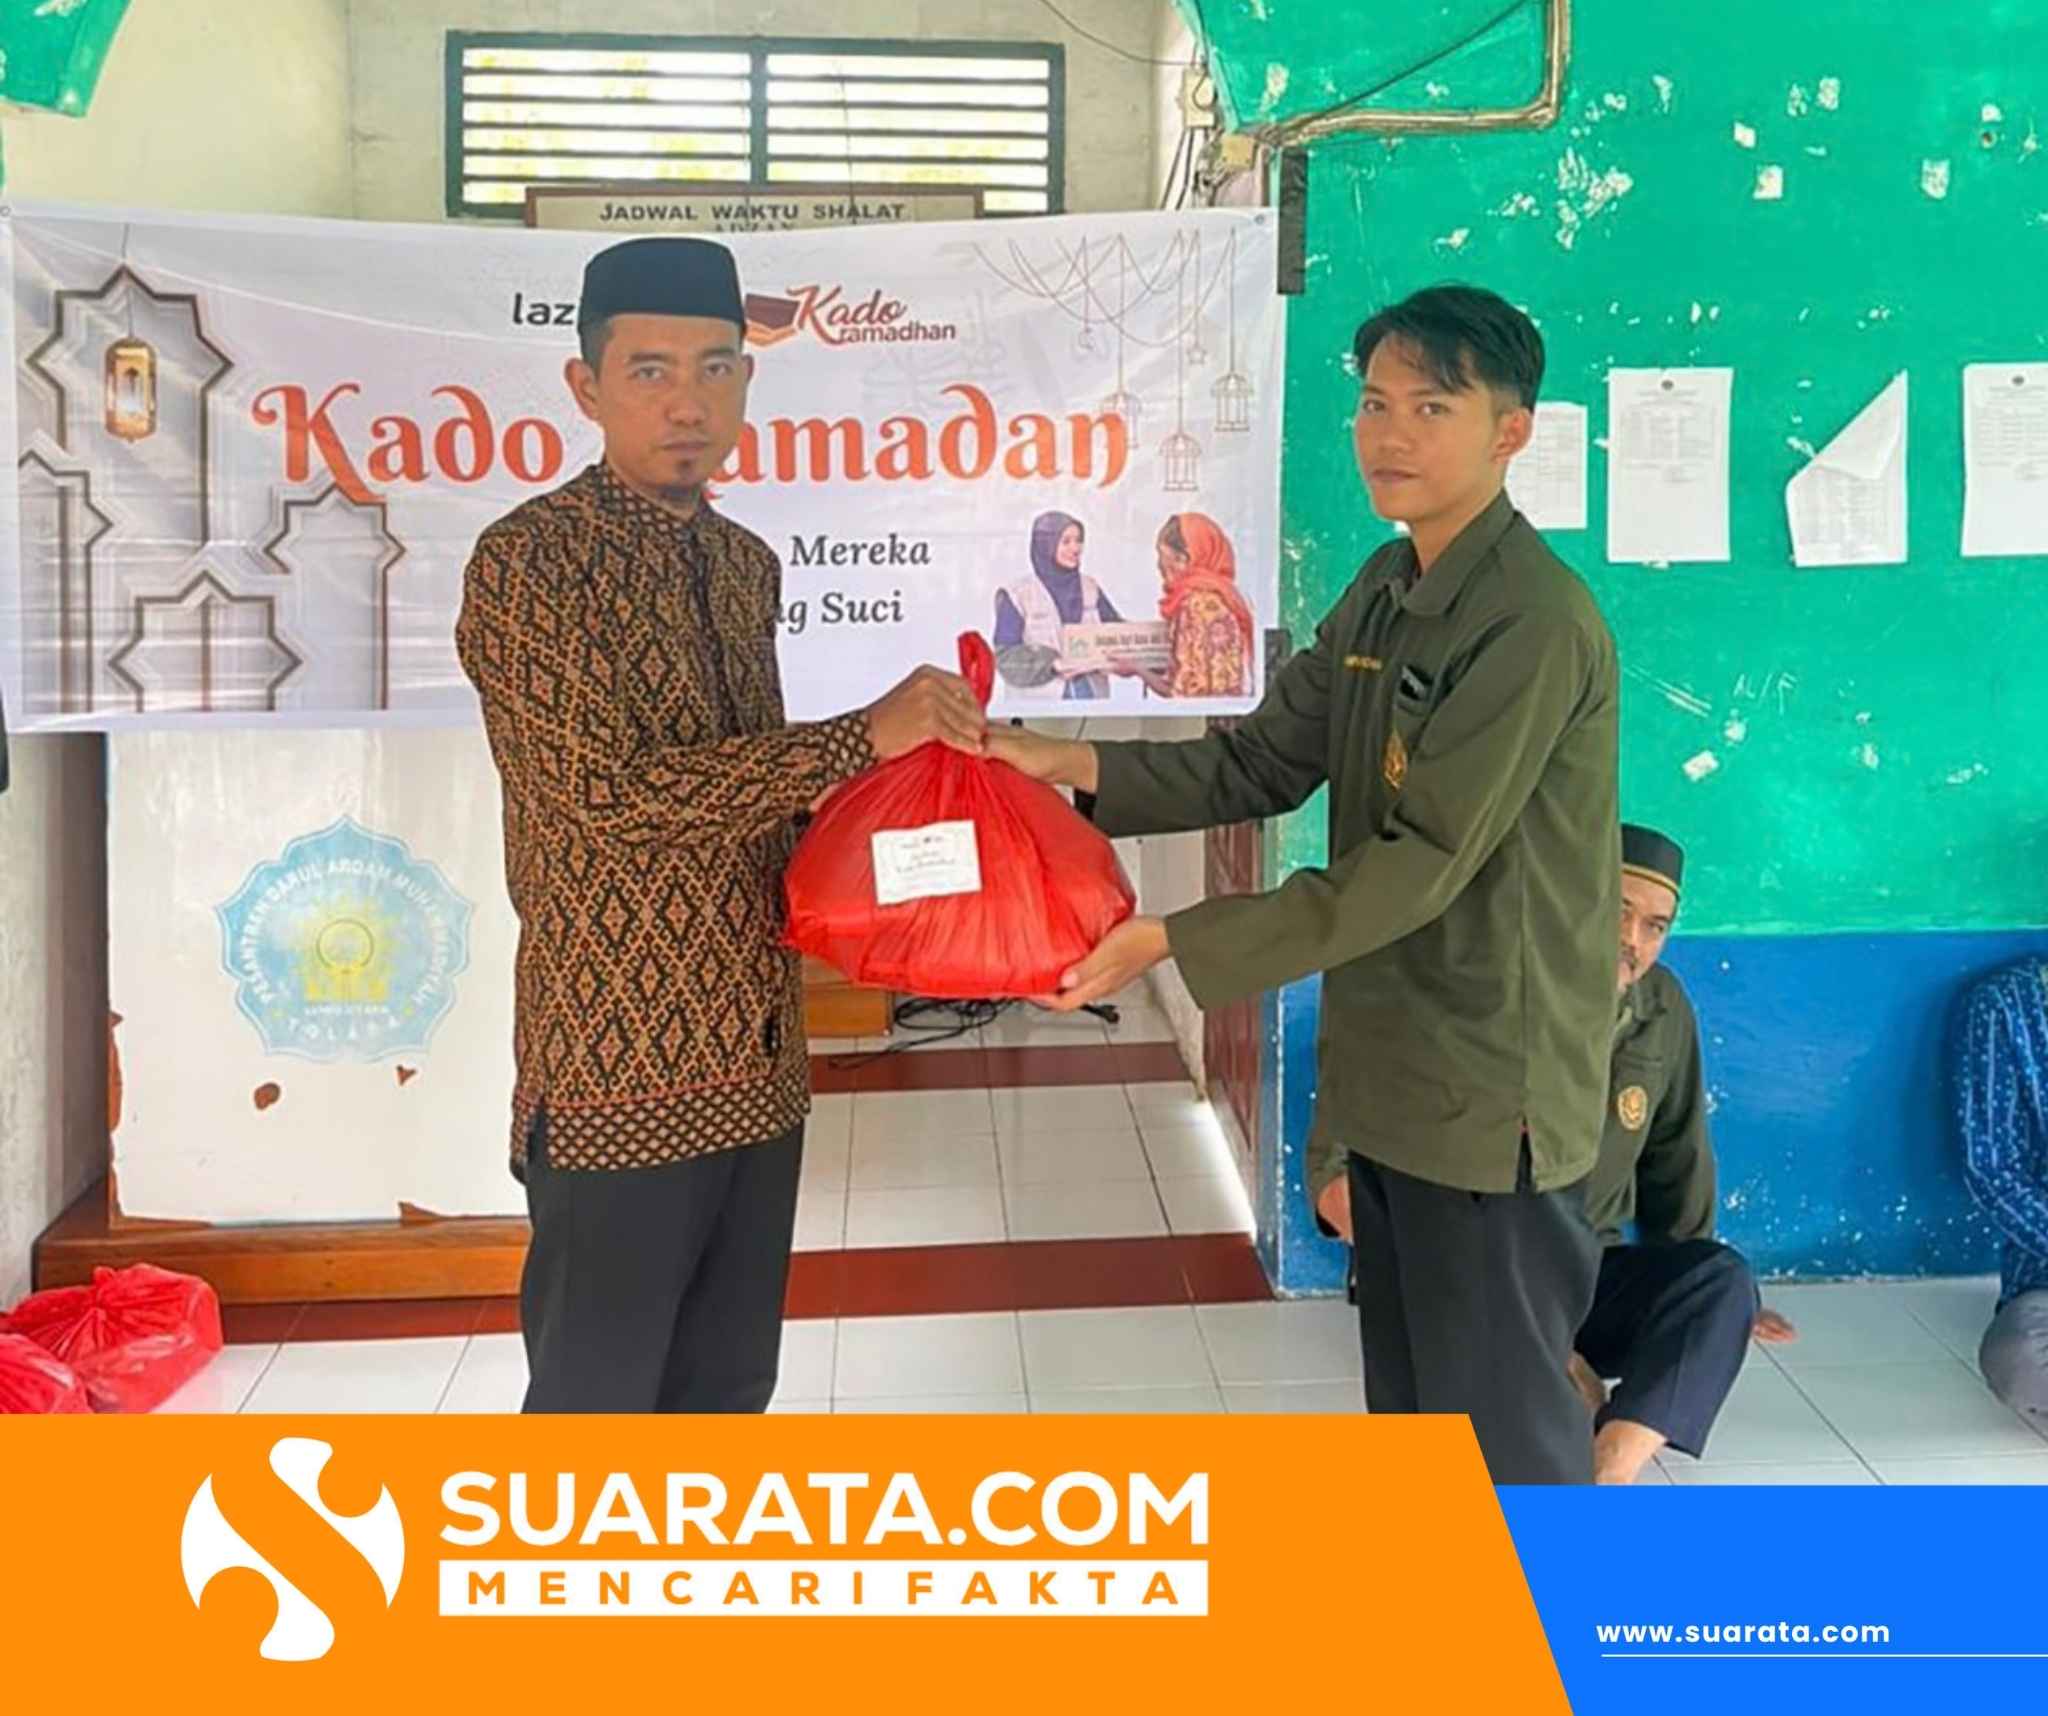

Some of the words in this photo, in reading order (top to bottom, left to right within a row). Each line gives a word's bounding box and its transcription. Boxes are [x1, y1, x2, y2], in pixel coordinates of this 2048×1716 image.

[601, 204, 698, 221] JADWAL
[711, 203, 799, 220] WAKTU
[813, 203, 906, 220] SHALAT
[513, 292, 575, 325] laz
[786, 285, 907, 345] Kado
[839, 320, 956, 343] ramadhan
[252, 383, 564, 505] Kado
[704, 383, 1129, 501] amadan
[789, 532, 932, 566] Mereka
[820, 590, 904, 623] Suci
